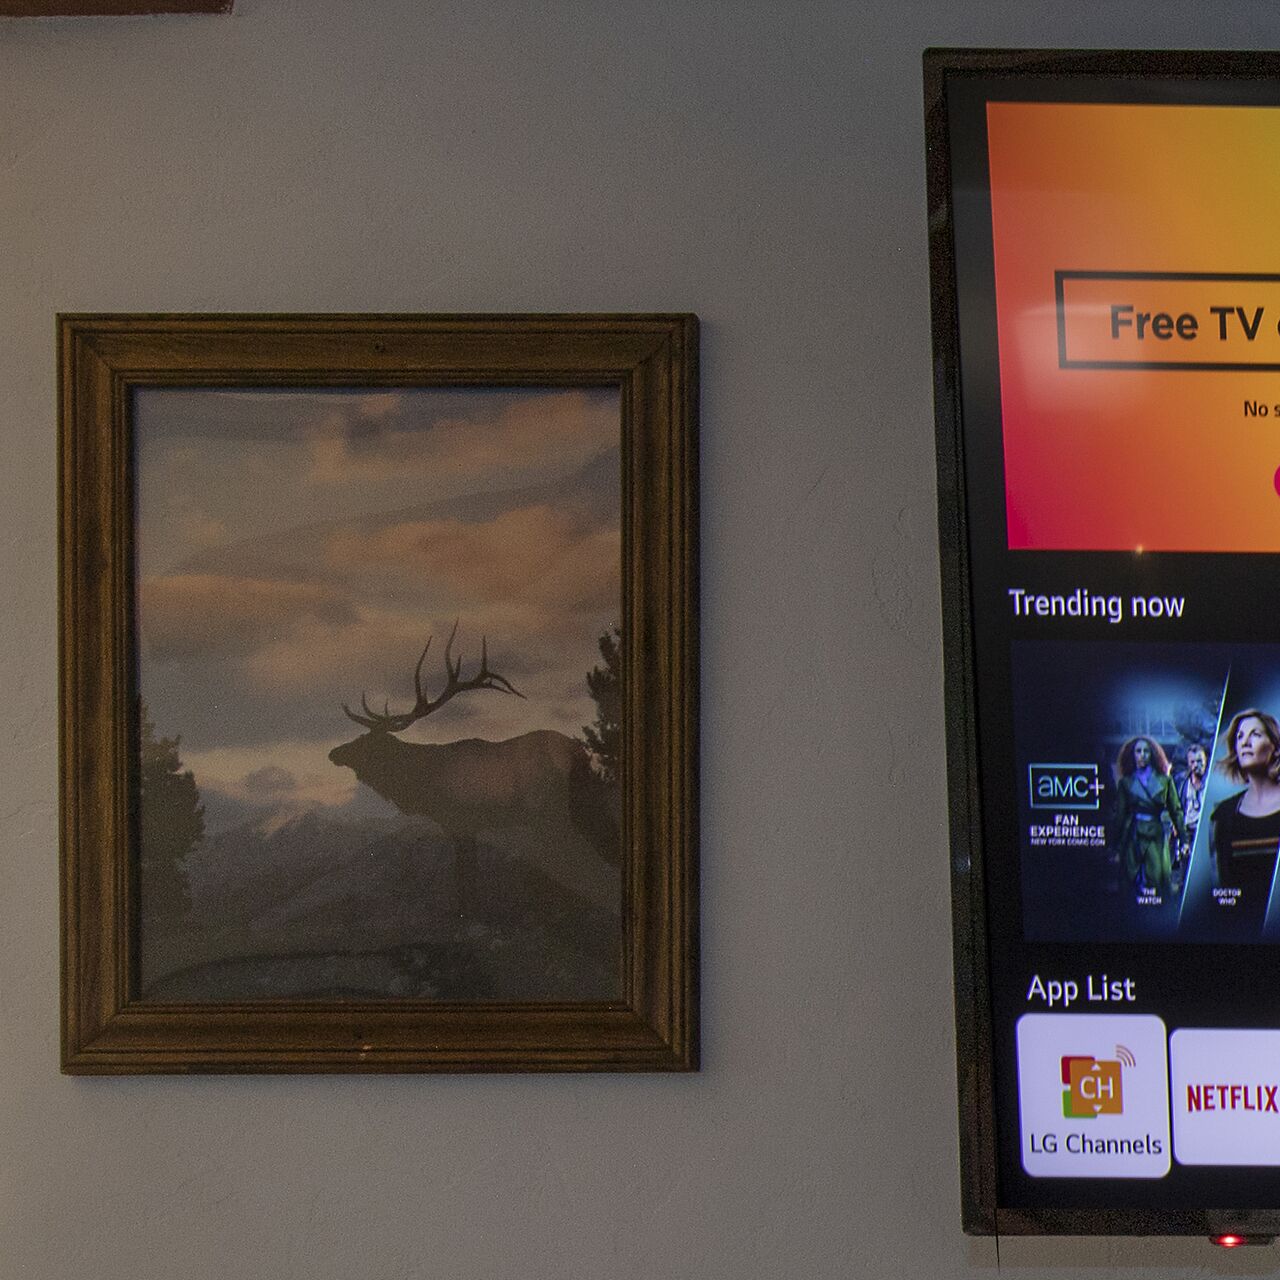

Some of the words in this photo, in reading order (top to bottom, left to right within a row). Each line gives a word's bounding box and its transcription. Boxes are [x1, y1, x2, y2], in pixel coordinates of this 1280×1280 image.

[1111, 305, 1199, 341] Free
[1210, 307, 1265, 341] TV
[1243, 400, 1270, 419] No
[1009, 588, 1122, 623] Trending
[1131, 595, 1186, 618] now
[1030, 825, 1106, 838] EXPERIENCE
[1054, 813, 1079, 826] FAN
[1027, 975, 1079, 1008] App
[1087, 975, 1136, 1002] List
[1079, 1076, 1115, 1101] CH
[1186, 1084, 1279, 1113] NETFLIX
[1030, 1134, 1058, 1154] LG
[1066, 1134, 1163, 1155] Channels
